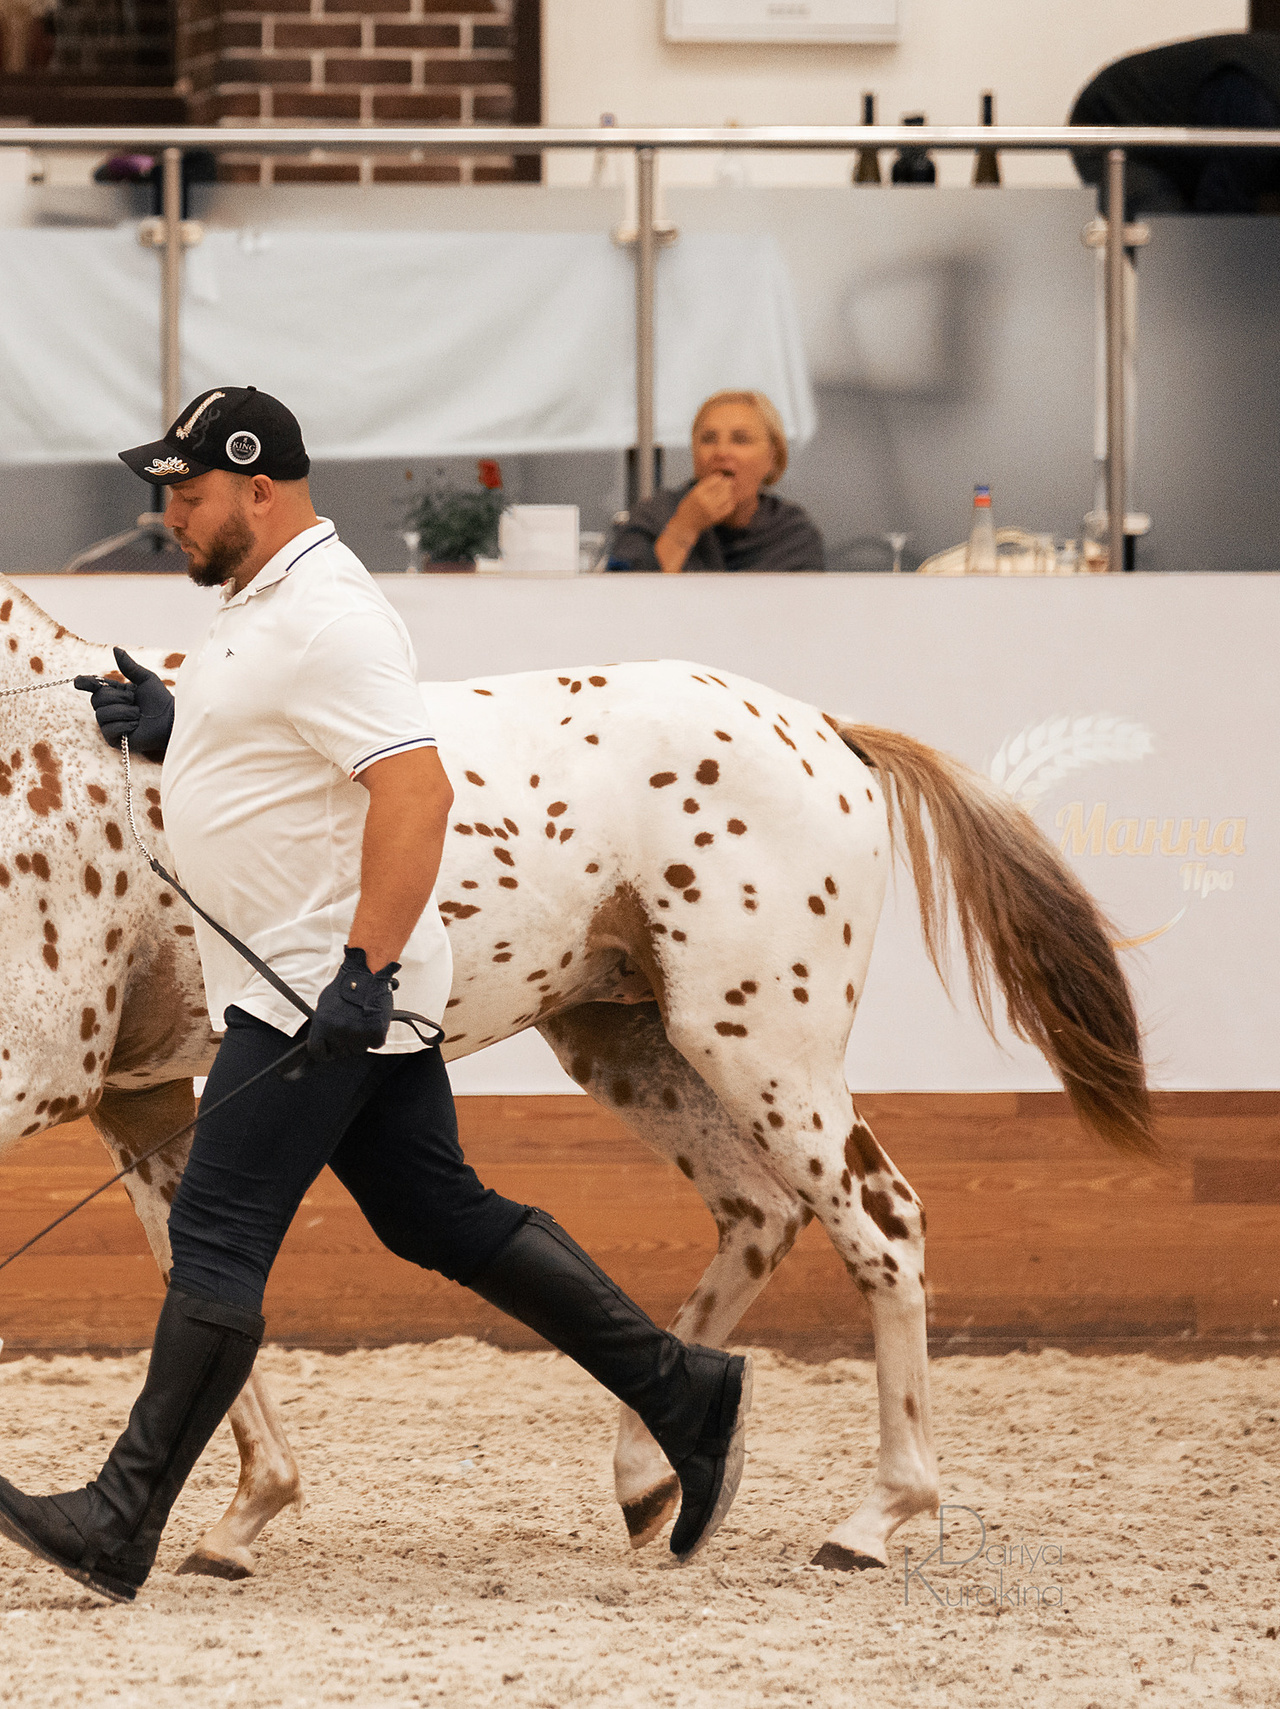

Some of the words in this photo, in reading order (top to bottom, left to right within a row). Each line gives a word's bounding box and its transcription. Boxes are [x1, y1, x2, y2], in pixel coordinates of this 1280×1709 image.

[232, 441, 256, 451] KING
[1056, 801, 1247, 857] Манна
[1179, 861, 1234, 899] Про
